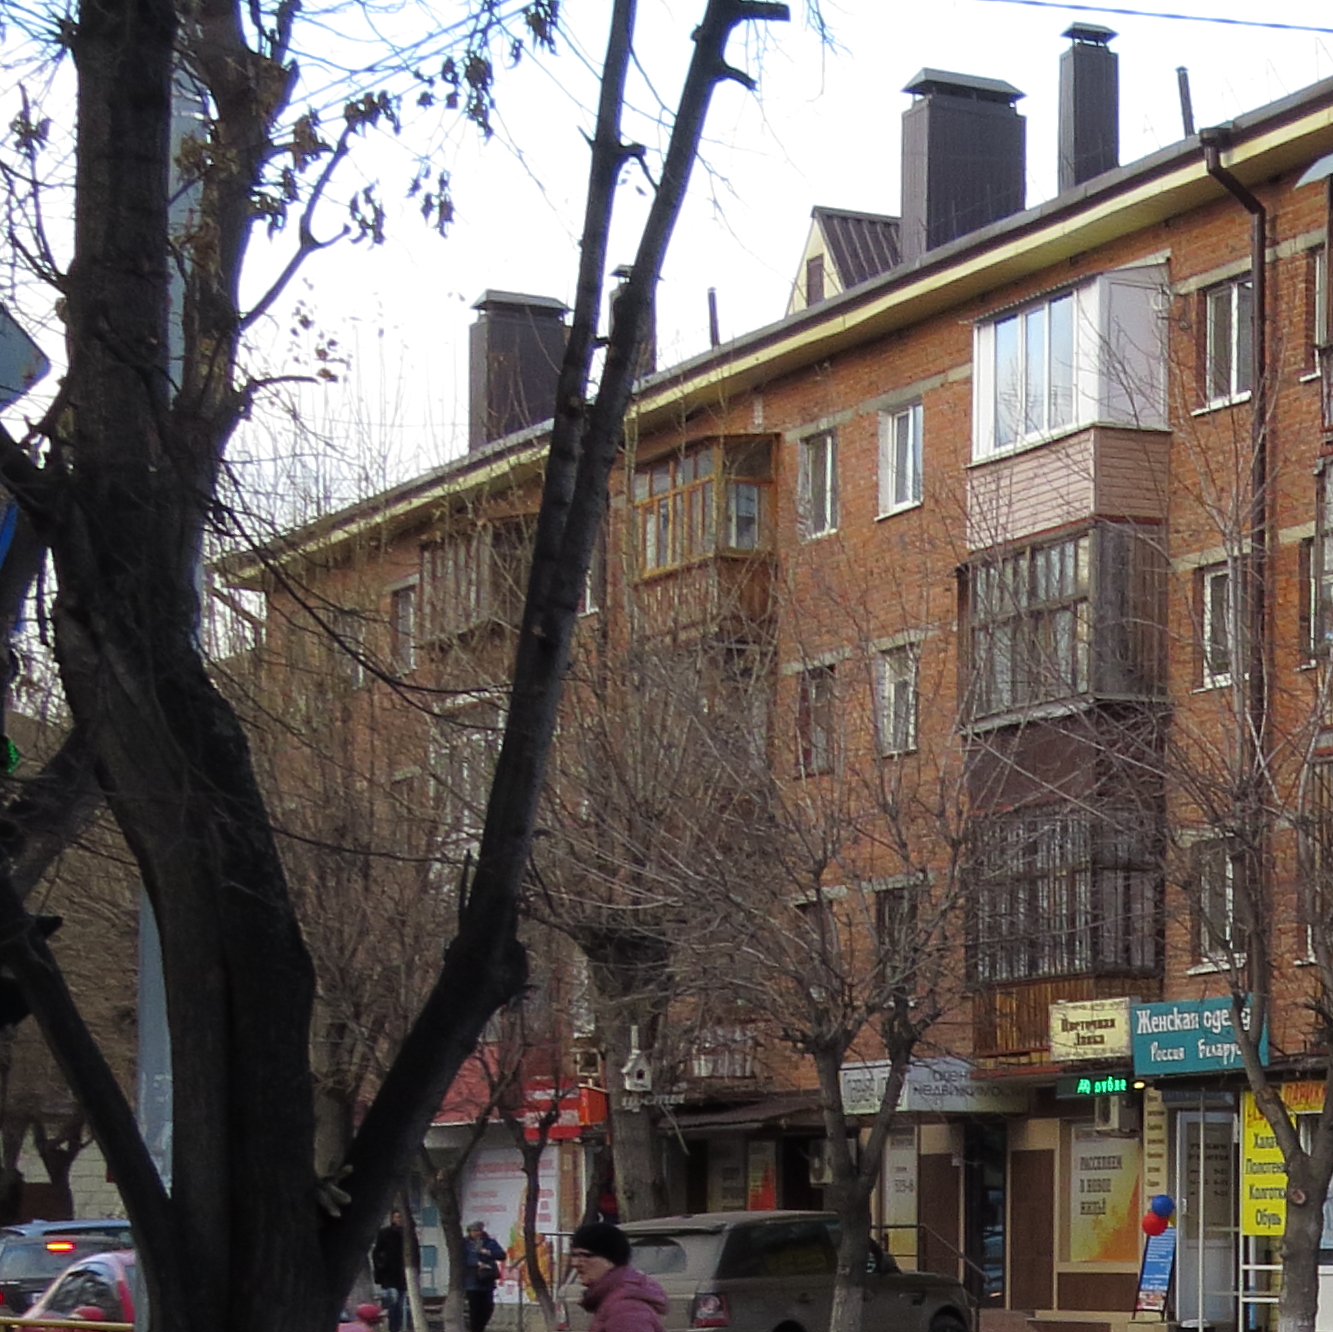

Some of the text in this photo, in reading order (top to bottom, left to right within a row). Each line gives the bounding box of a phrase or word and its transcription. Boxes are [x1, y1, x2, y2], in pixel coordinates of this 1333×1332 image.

[1136, 1007, 1199, 1034] Женская
[1150, 1038, 1242, 1065] Россия Беларус
